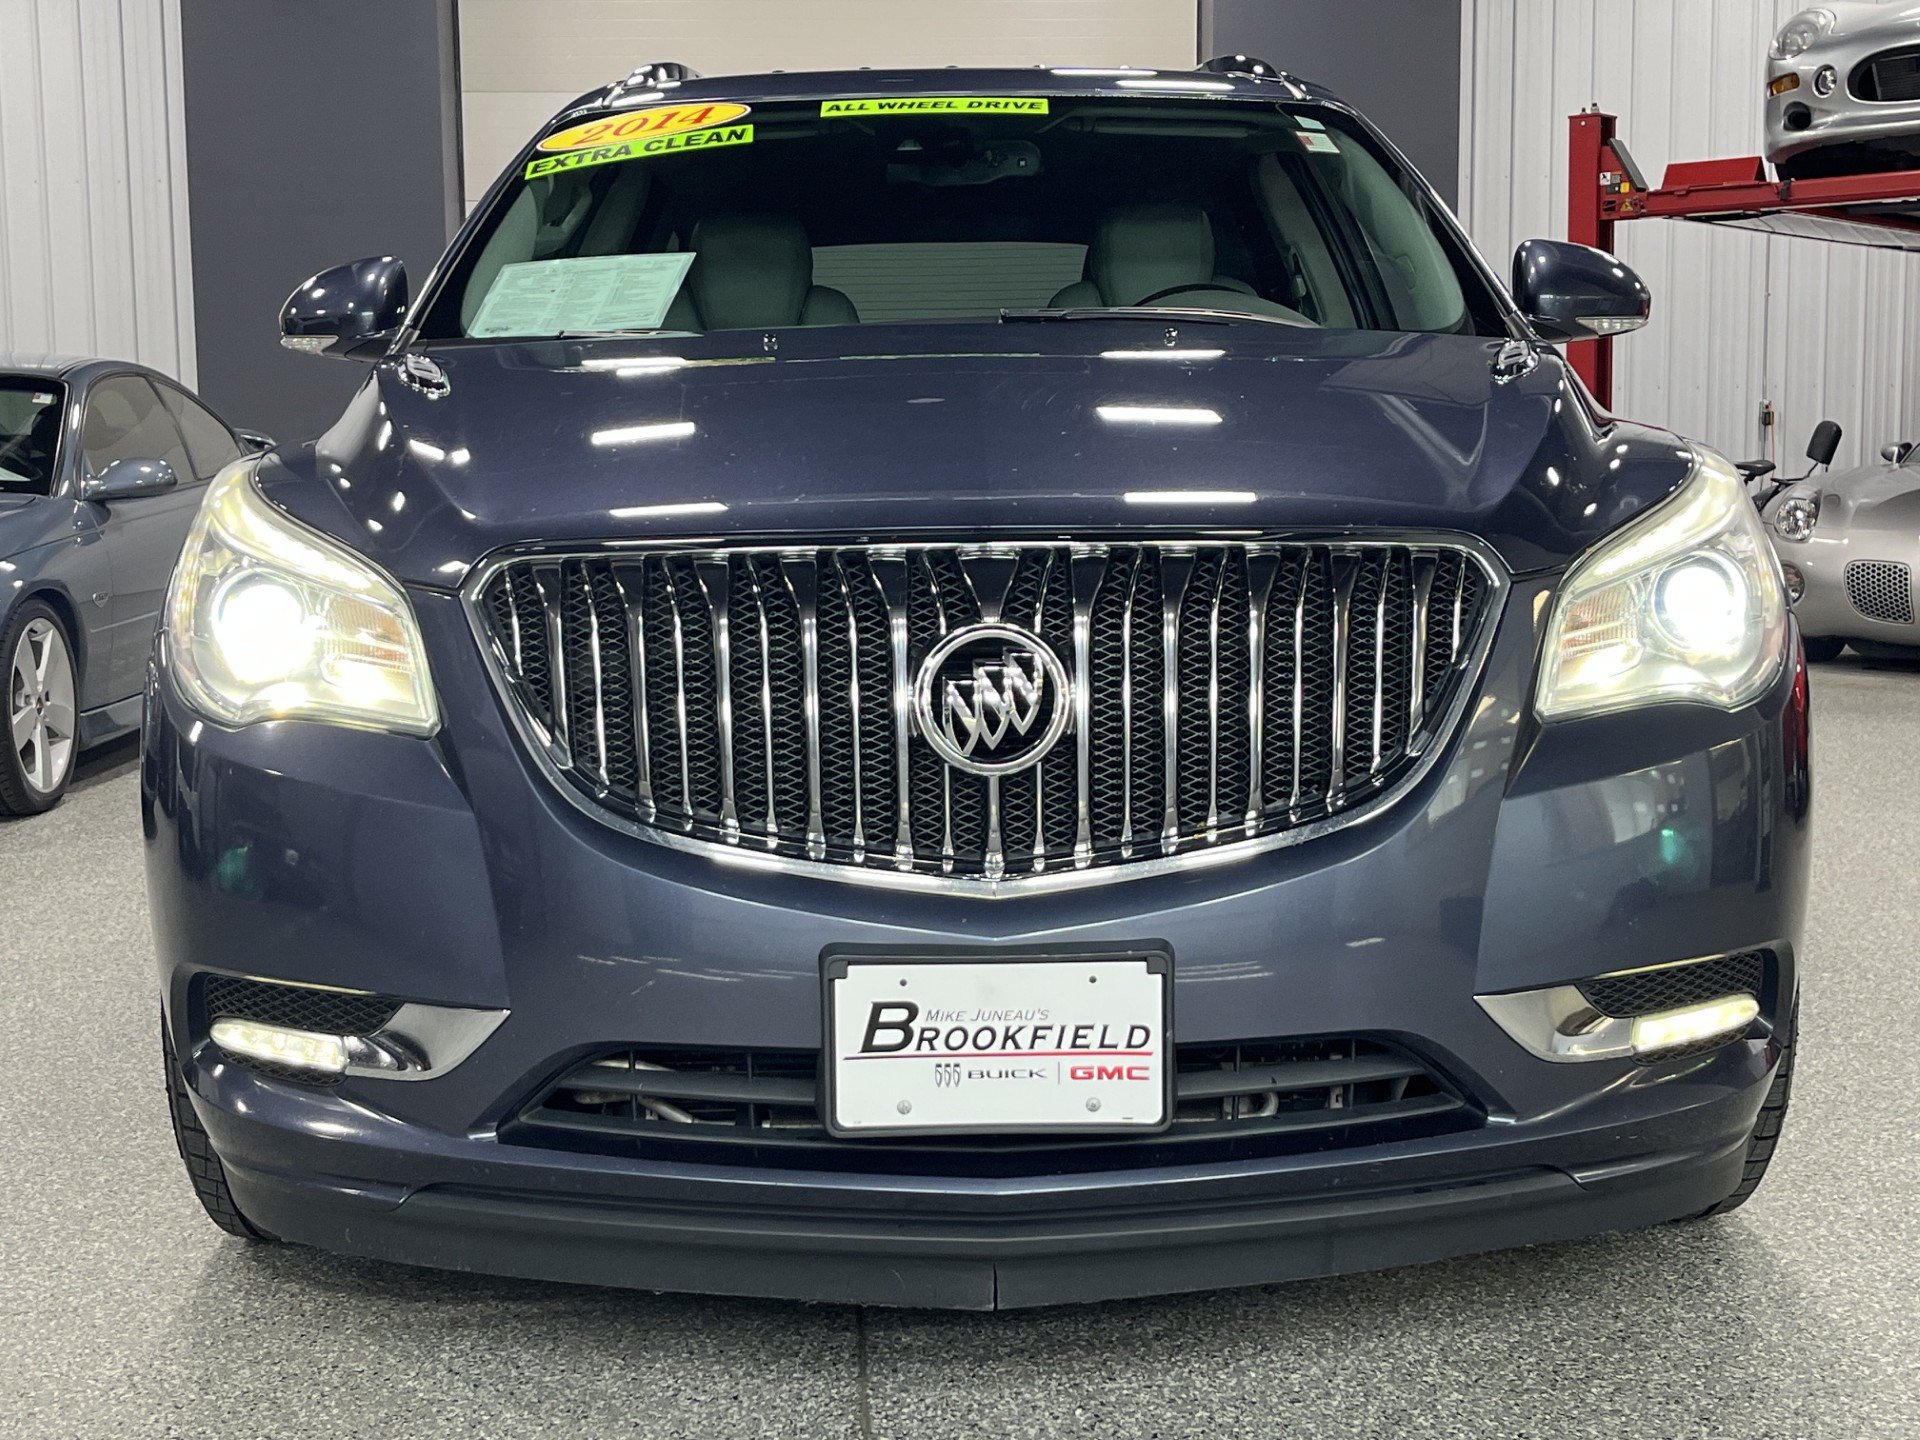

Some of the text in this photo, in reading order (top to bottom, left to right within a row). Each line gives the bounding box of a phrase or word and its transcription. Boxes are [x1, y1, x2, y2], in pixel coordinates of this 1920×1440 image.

[573, 106, 715, 146] 2014
[825, 100, 1043, 113] ALL WHEEL DRIVE
[530, 127, 748, 175] EXTRA CLEAN
[858, 1000, 1152, 1053] BROOKFIELD
[967, 1065, 1150, 1081] BUICK GMC
